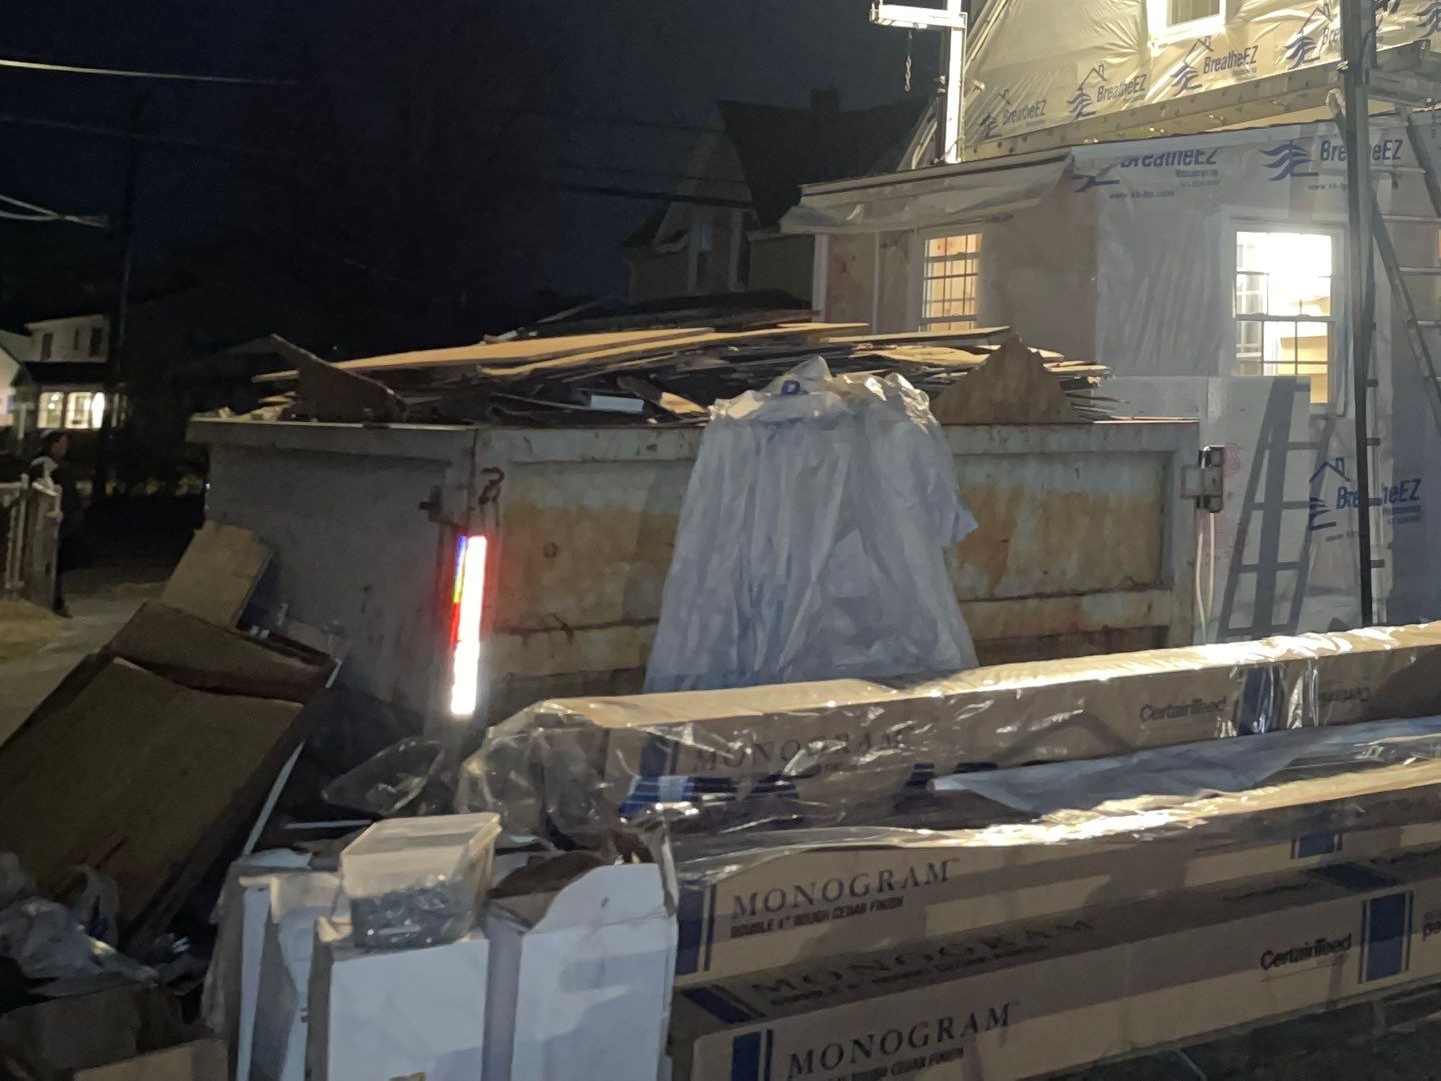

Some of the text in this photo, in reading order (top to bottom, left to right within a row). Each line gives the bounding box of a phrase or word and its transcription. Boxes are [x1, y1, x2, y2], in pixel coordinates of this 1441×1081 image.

[1203, 45, 1259, 75] BreatheEZ
[1096, 74, 1148, 103] BreatheEZ
[731, 860, 955, 920] MONOGRAM
[730, 920, 775, 939] DOUBLE
[793, 911, 831, 927] ROUGH
[832, 903, 867, 920] CEDAR
[869, 896, 904, 913] FINISH
[1260, 933, 1352, 970] CertainTeed
[788, 1002, 1011, 1081] MONOGRAM
[891, 1057, 926, 1077] CEDAR
[928, 1046, 964, 1068] FINISH
